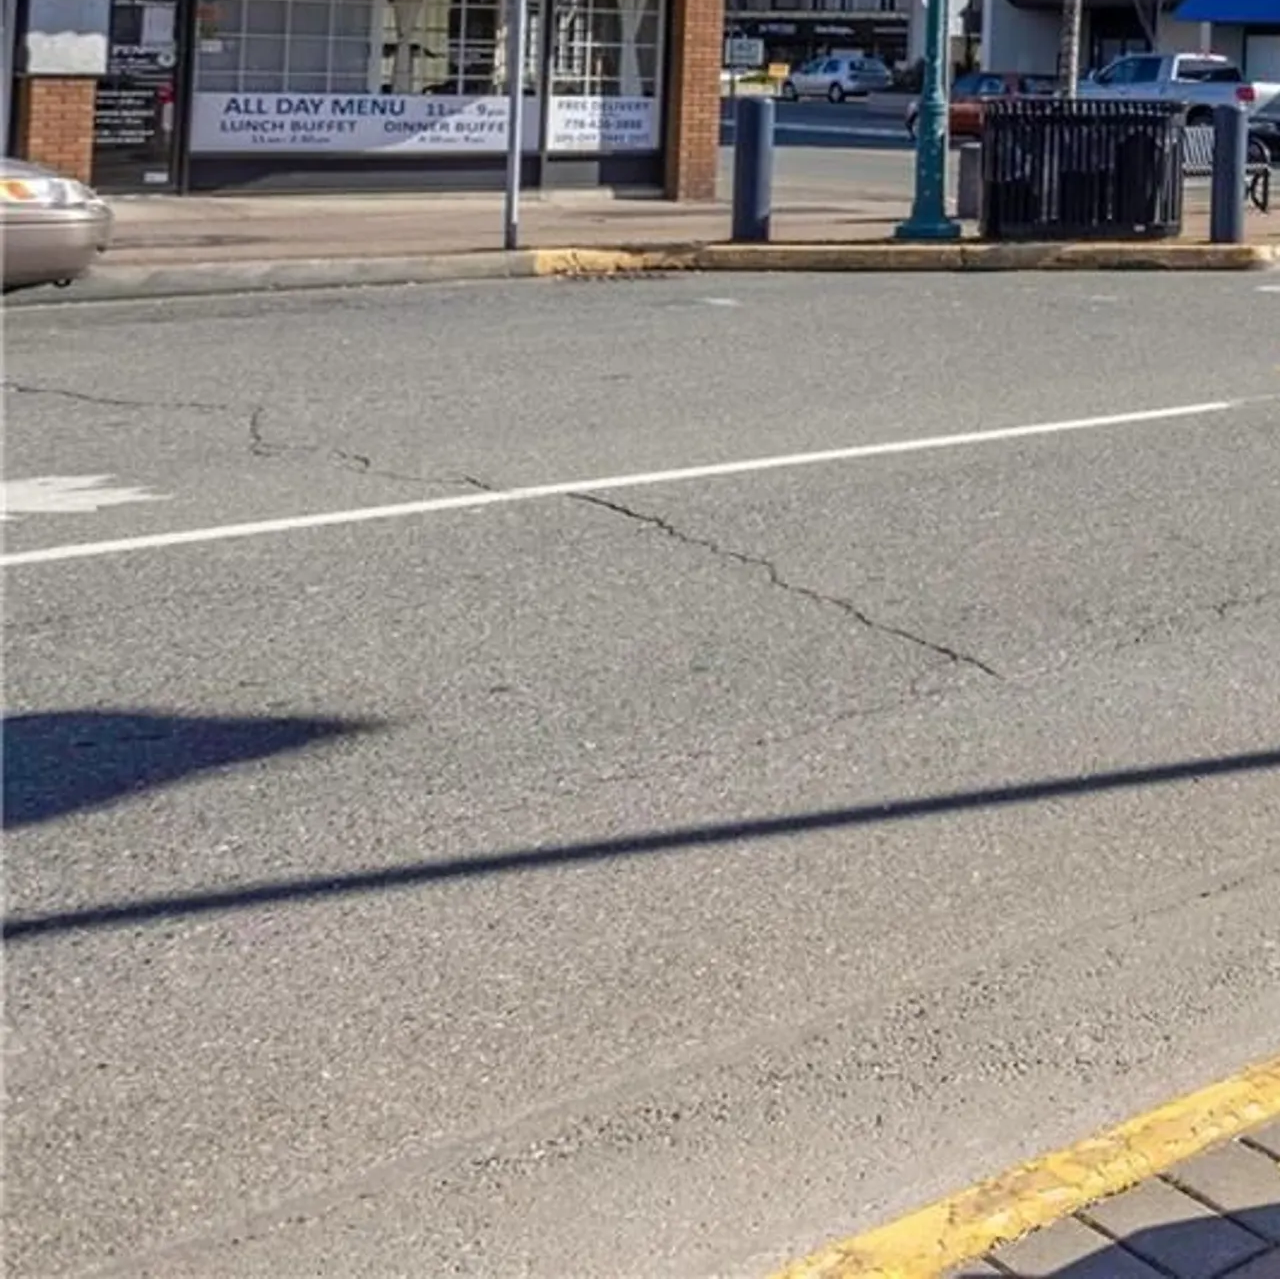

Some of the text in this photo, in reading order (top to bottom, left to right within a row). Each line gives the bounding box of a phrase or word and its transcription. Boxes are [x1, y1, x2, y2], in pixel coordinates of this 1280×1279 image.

[222, 97, 268, 115] ALL
[275, 97, 324, 115] DAY
[331, 98, 405, 117] MENU
[220, 120, 505, 134] LUNCH BUFFET DINNER BUFFE
